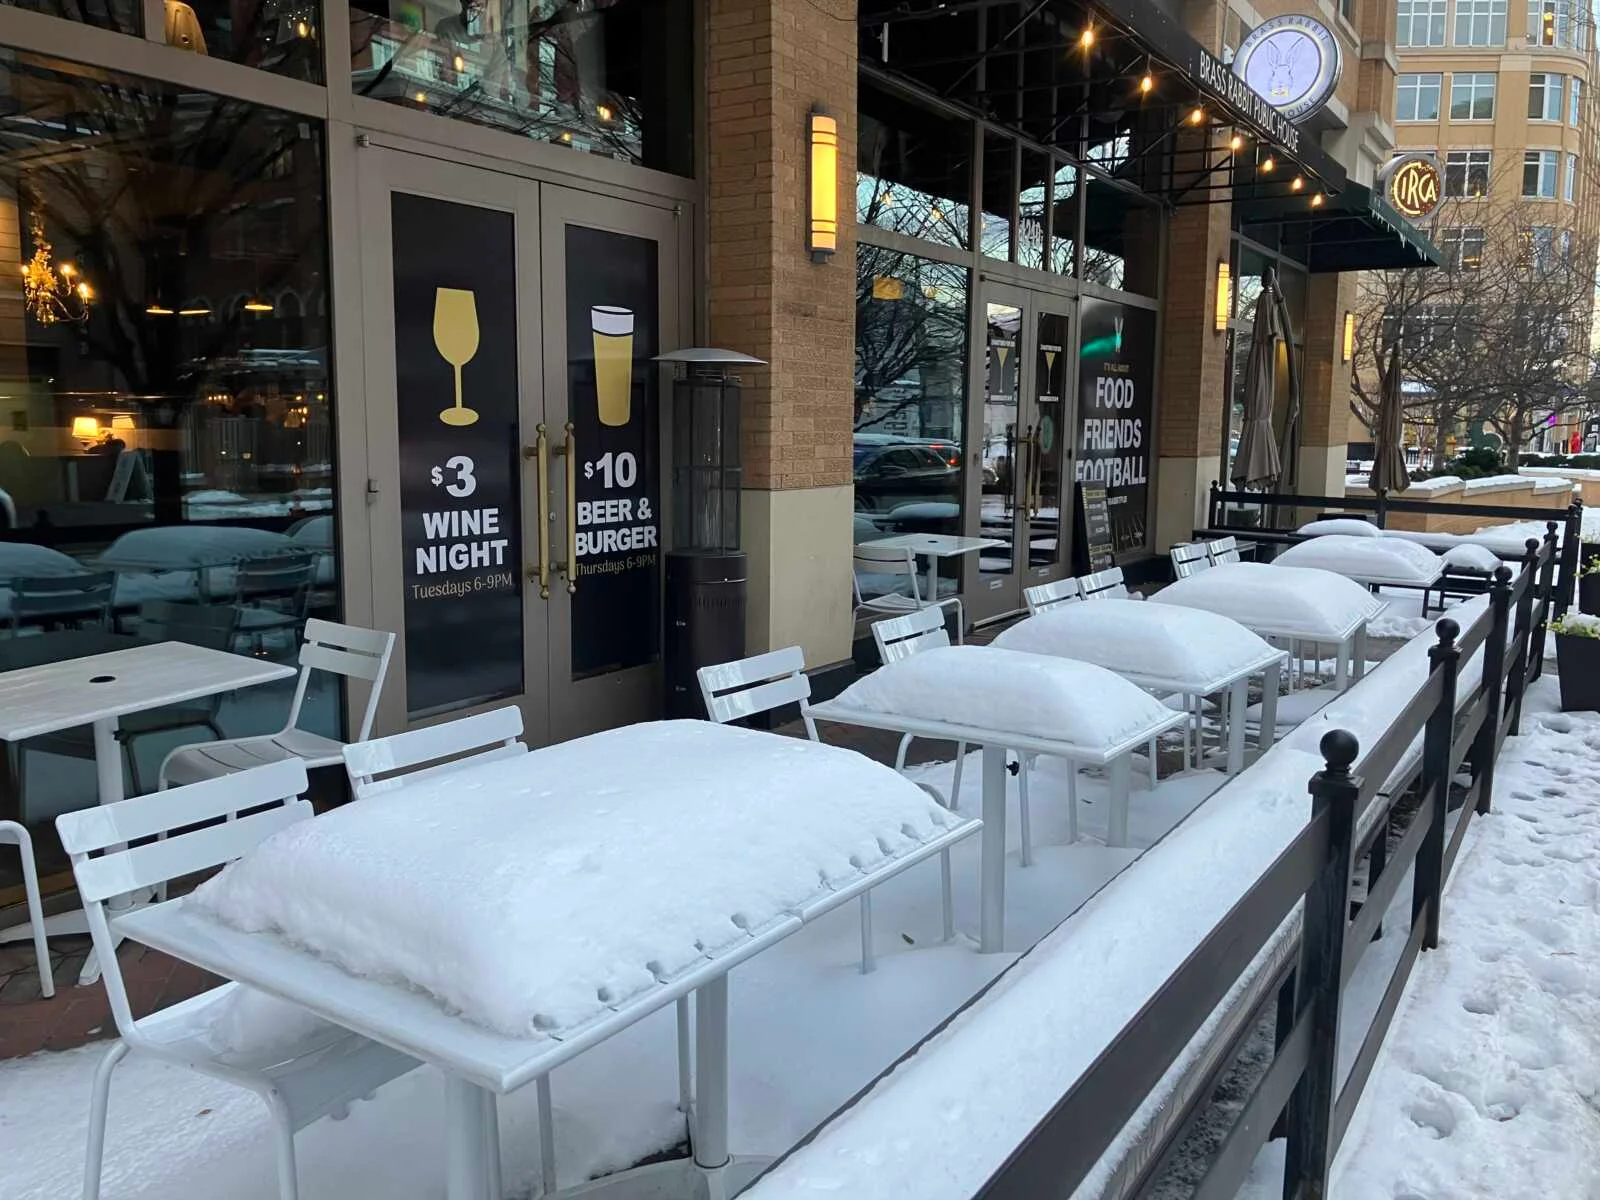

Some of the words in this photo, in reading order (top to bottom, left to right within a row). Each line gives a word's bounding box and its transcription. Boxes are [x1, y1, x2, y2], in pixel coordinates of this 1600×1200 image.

[1244, 18, 1282, 48] BRASS
[1287, 16, 1329, 41] RABBIT
[1200, 50, 1226, 95] BRASS
[1228, 73, 1253, 116] RABBIT
[1254, 96, 1276, 135] PUBLIC
[1277, 118, 1299, 153] HOUSE
[1393, 162, 1437, 214] CIRCA
[1096, 377, 1134, 409] FOOD
[1083, 418, 1142, 450] FRIENDS
[431, 455, 477, 498] $3
[584, 451, 637, 489] $10
[1075, 456, 1146, 488] FOOTBALL
[422, 508, 499, 540] WINE
[577, 499, 632, 526] BEER
[637, 497, 652, 520] &
[416, 539, 508, 575] NIGHT
[575, 526, 658, 556] BURGER
[576, 561, 625, 577] Thursdays
[627, 554, 657, 570] 6-9PM
[412, 580, 471, 600] Tuesdays
[474, 572, 513, 592] 6-9PM
